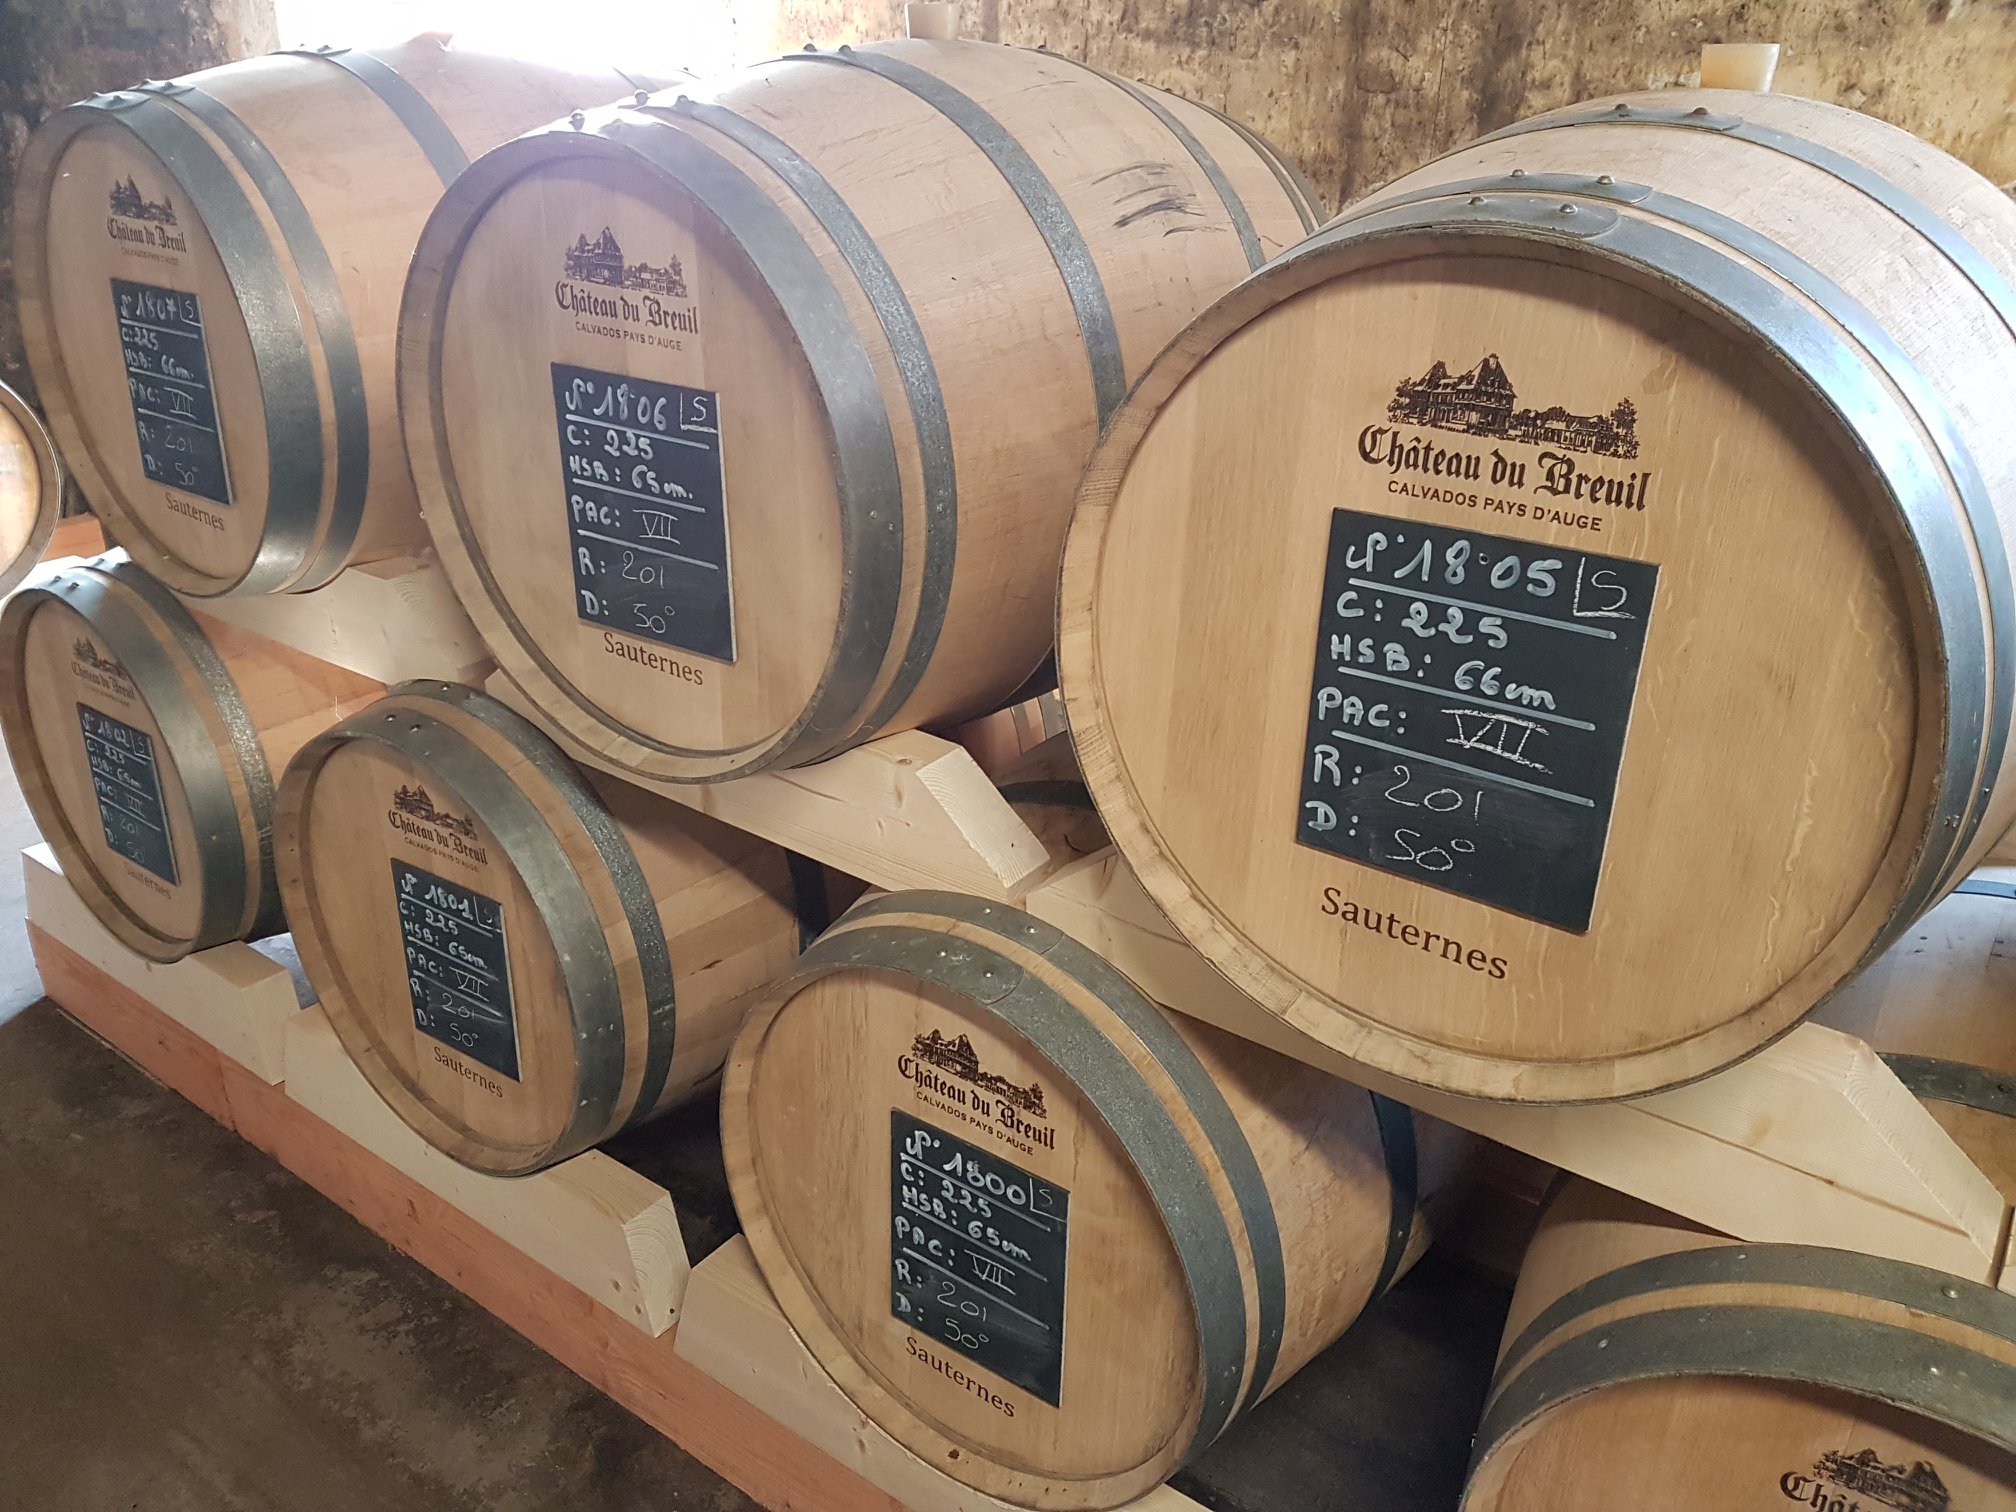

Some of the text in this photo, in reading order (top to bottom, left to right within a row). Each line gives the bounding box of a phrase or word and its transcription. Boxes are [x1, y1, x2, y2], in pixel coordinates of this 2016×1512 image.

[555, 280, 699, 334] Château du Breuil
[135, 327, 159, 350] 225
[575, 322, 682, 351] CALVADOS PAYS D'AUGE
[164, 387, 198, 420] VII
[594, 383, 667, 431] 1806
[138, 421, 154, 442] R:
[567, 425, 653, 459] C: 225
[570, 455, 621, 482] HSB:
[1358, 424, 1652, 512] Château du Breuil
[165, 492, 224, 531] Sauternes
[571, 494, 680, 545] PAC: VII
[1388, 480, 1602, 532] CALVADOS PAYS D'AUGE
[578, 547, 665, 589] R: 201
[581, 590, 609, 616] D:
[1336, 590, 1508, 649] C: 225
[604, 632, 703, 685] Sauternes
[1330, 633, 1432, 678] HSB:
[105, 745, 125, 763] 225
[1317, 686, 1554, 775] PAC: VII
[1313, 744, 1483, 826] R: 201
[389, 809, 488, 865] Château du Breuil
[1305, 800, 1359, 837] D:
[400, 901, 458, 935] C: 225
[404, 920, 439, 946] HSB:
[1321, 886, 1508, 980] Sauternes
[407, 947, 490, 1002] PAC: VII
[410, 978, 431, 1001] R:
[416, 1009, 436, 1027] D:
[434, 1046, 503, 1098] Sauternes
[898, 1054, 1056, 1150] Château du Breuil
[916, 1091, 1034, 1155] CALVADOS PAYS D'AUGE
[901, 1162, 992, 1218] C: 225
[943, 1153, 1026, 1206] 1800
[902, 1185, 958, 1225] HSB:
[895, 1216, 1016, 1296] PAC: VII
[895, 1259, 987, 1322] R: 201
[895, 1292, 923, 1321] D:
[905, 1336, 1015, 1418] Sauternes
